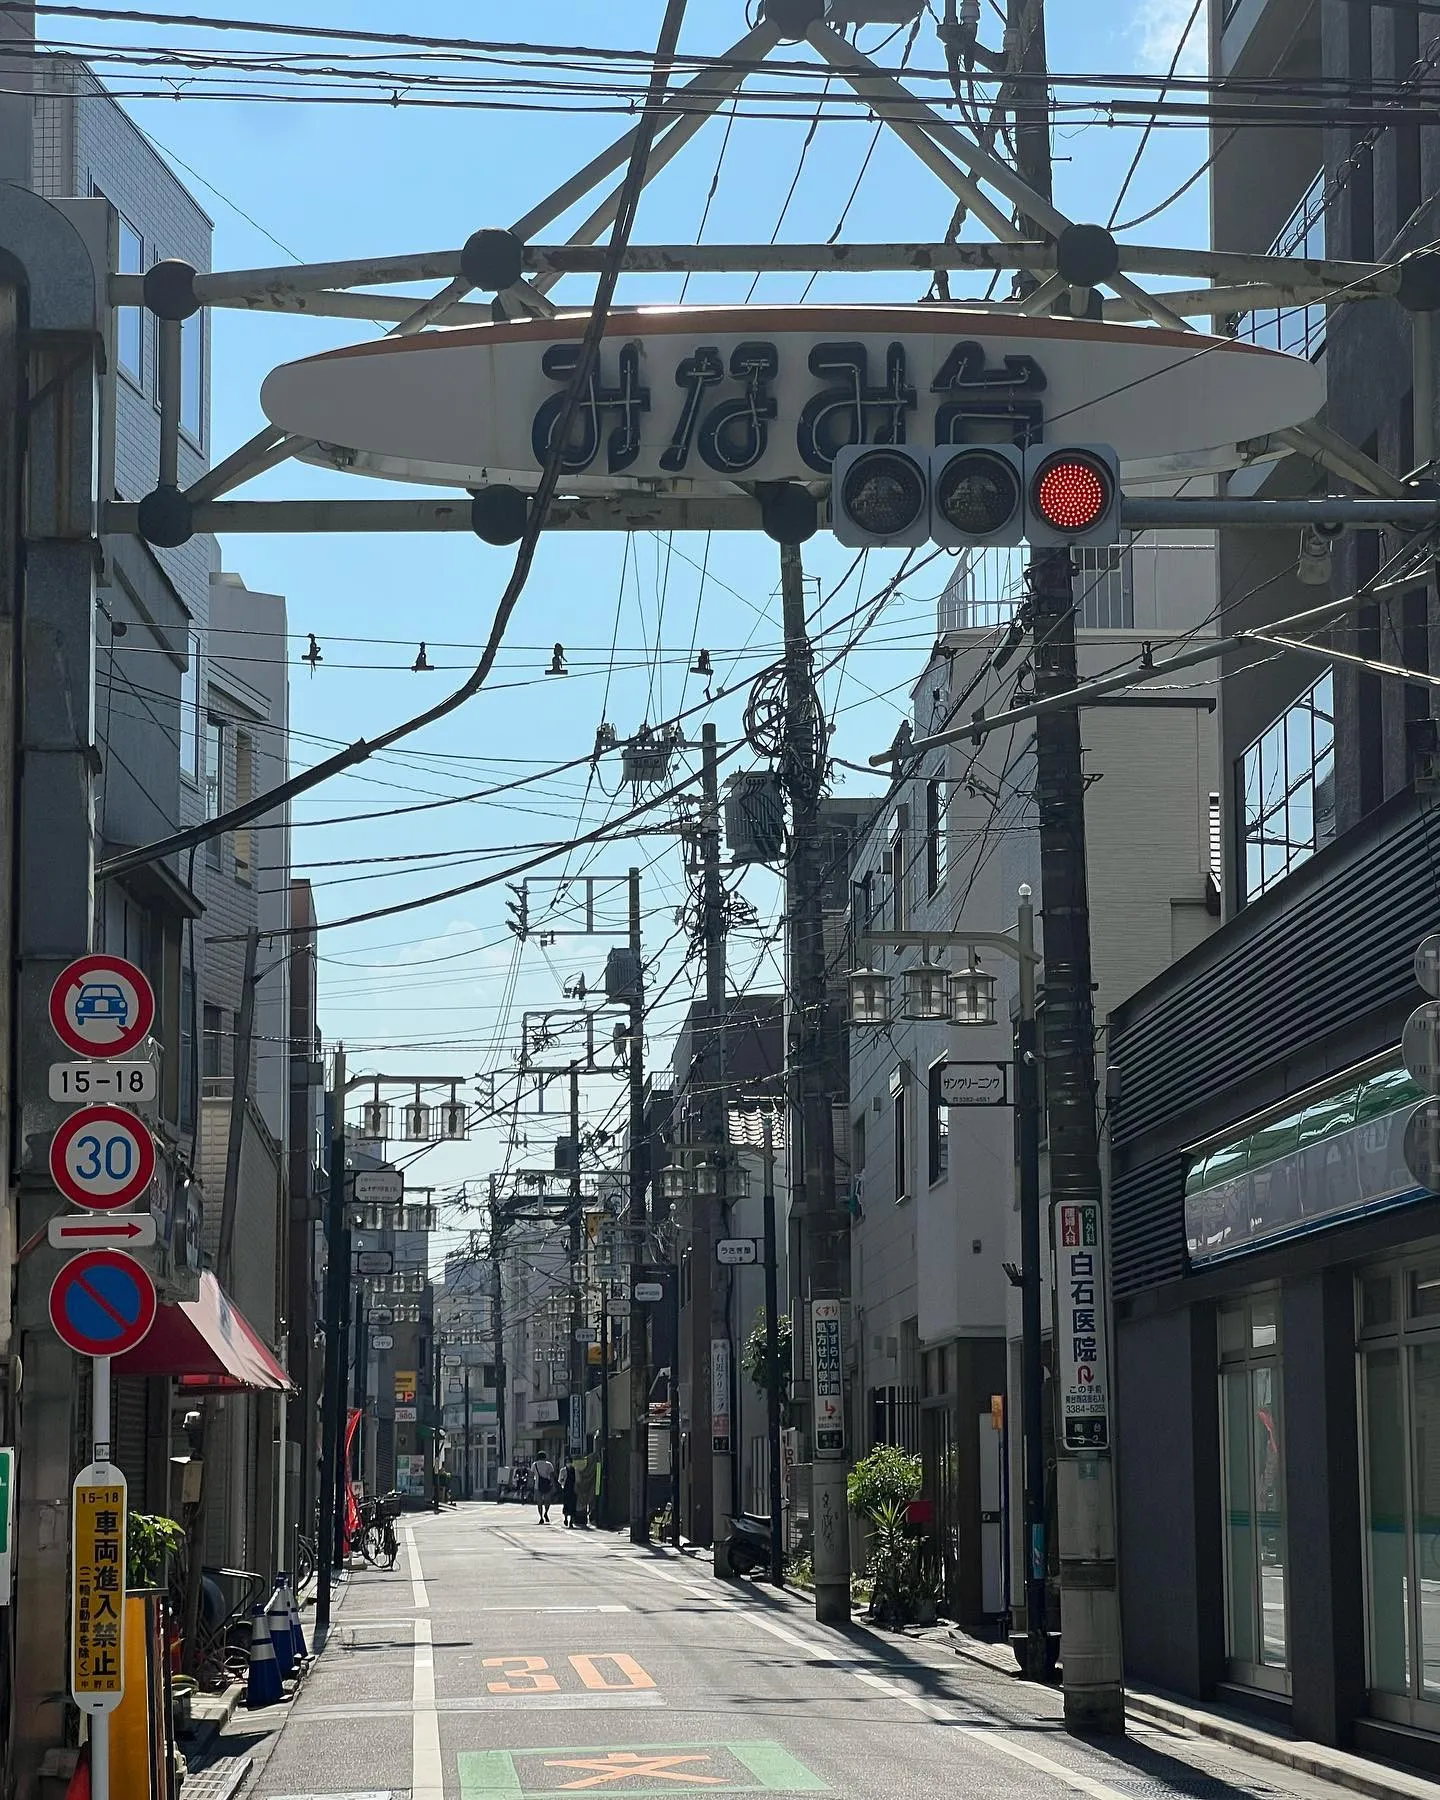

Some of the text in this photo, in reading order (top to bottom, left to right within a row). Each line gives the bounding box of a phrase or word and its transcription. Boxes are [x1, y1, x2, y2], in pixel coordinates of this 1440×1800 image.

[531, 340, 1047, 475] みなみ台
[61, 1070, 145, 1094] 15-18
[75, 1135, 133, 1181] 30
[1069, 1251, 1097, 1362] 白石医院
[81, 1492, 120, 1504] 15-18
[92, 1509, 119, 1677] 車両進入禁止
[482, 1653, 657, 1693] 30
